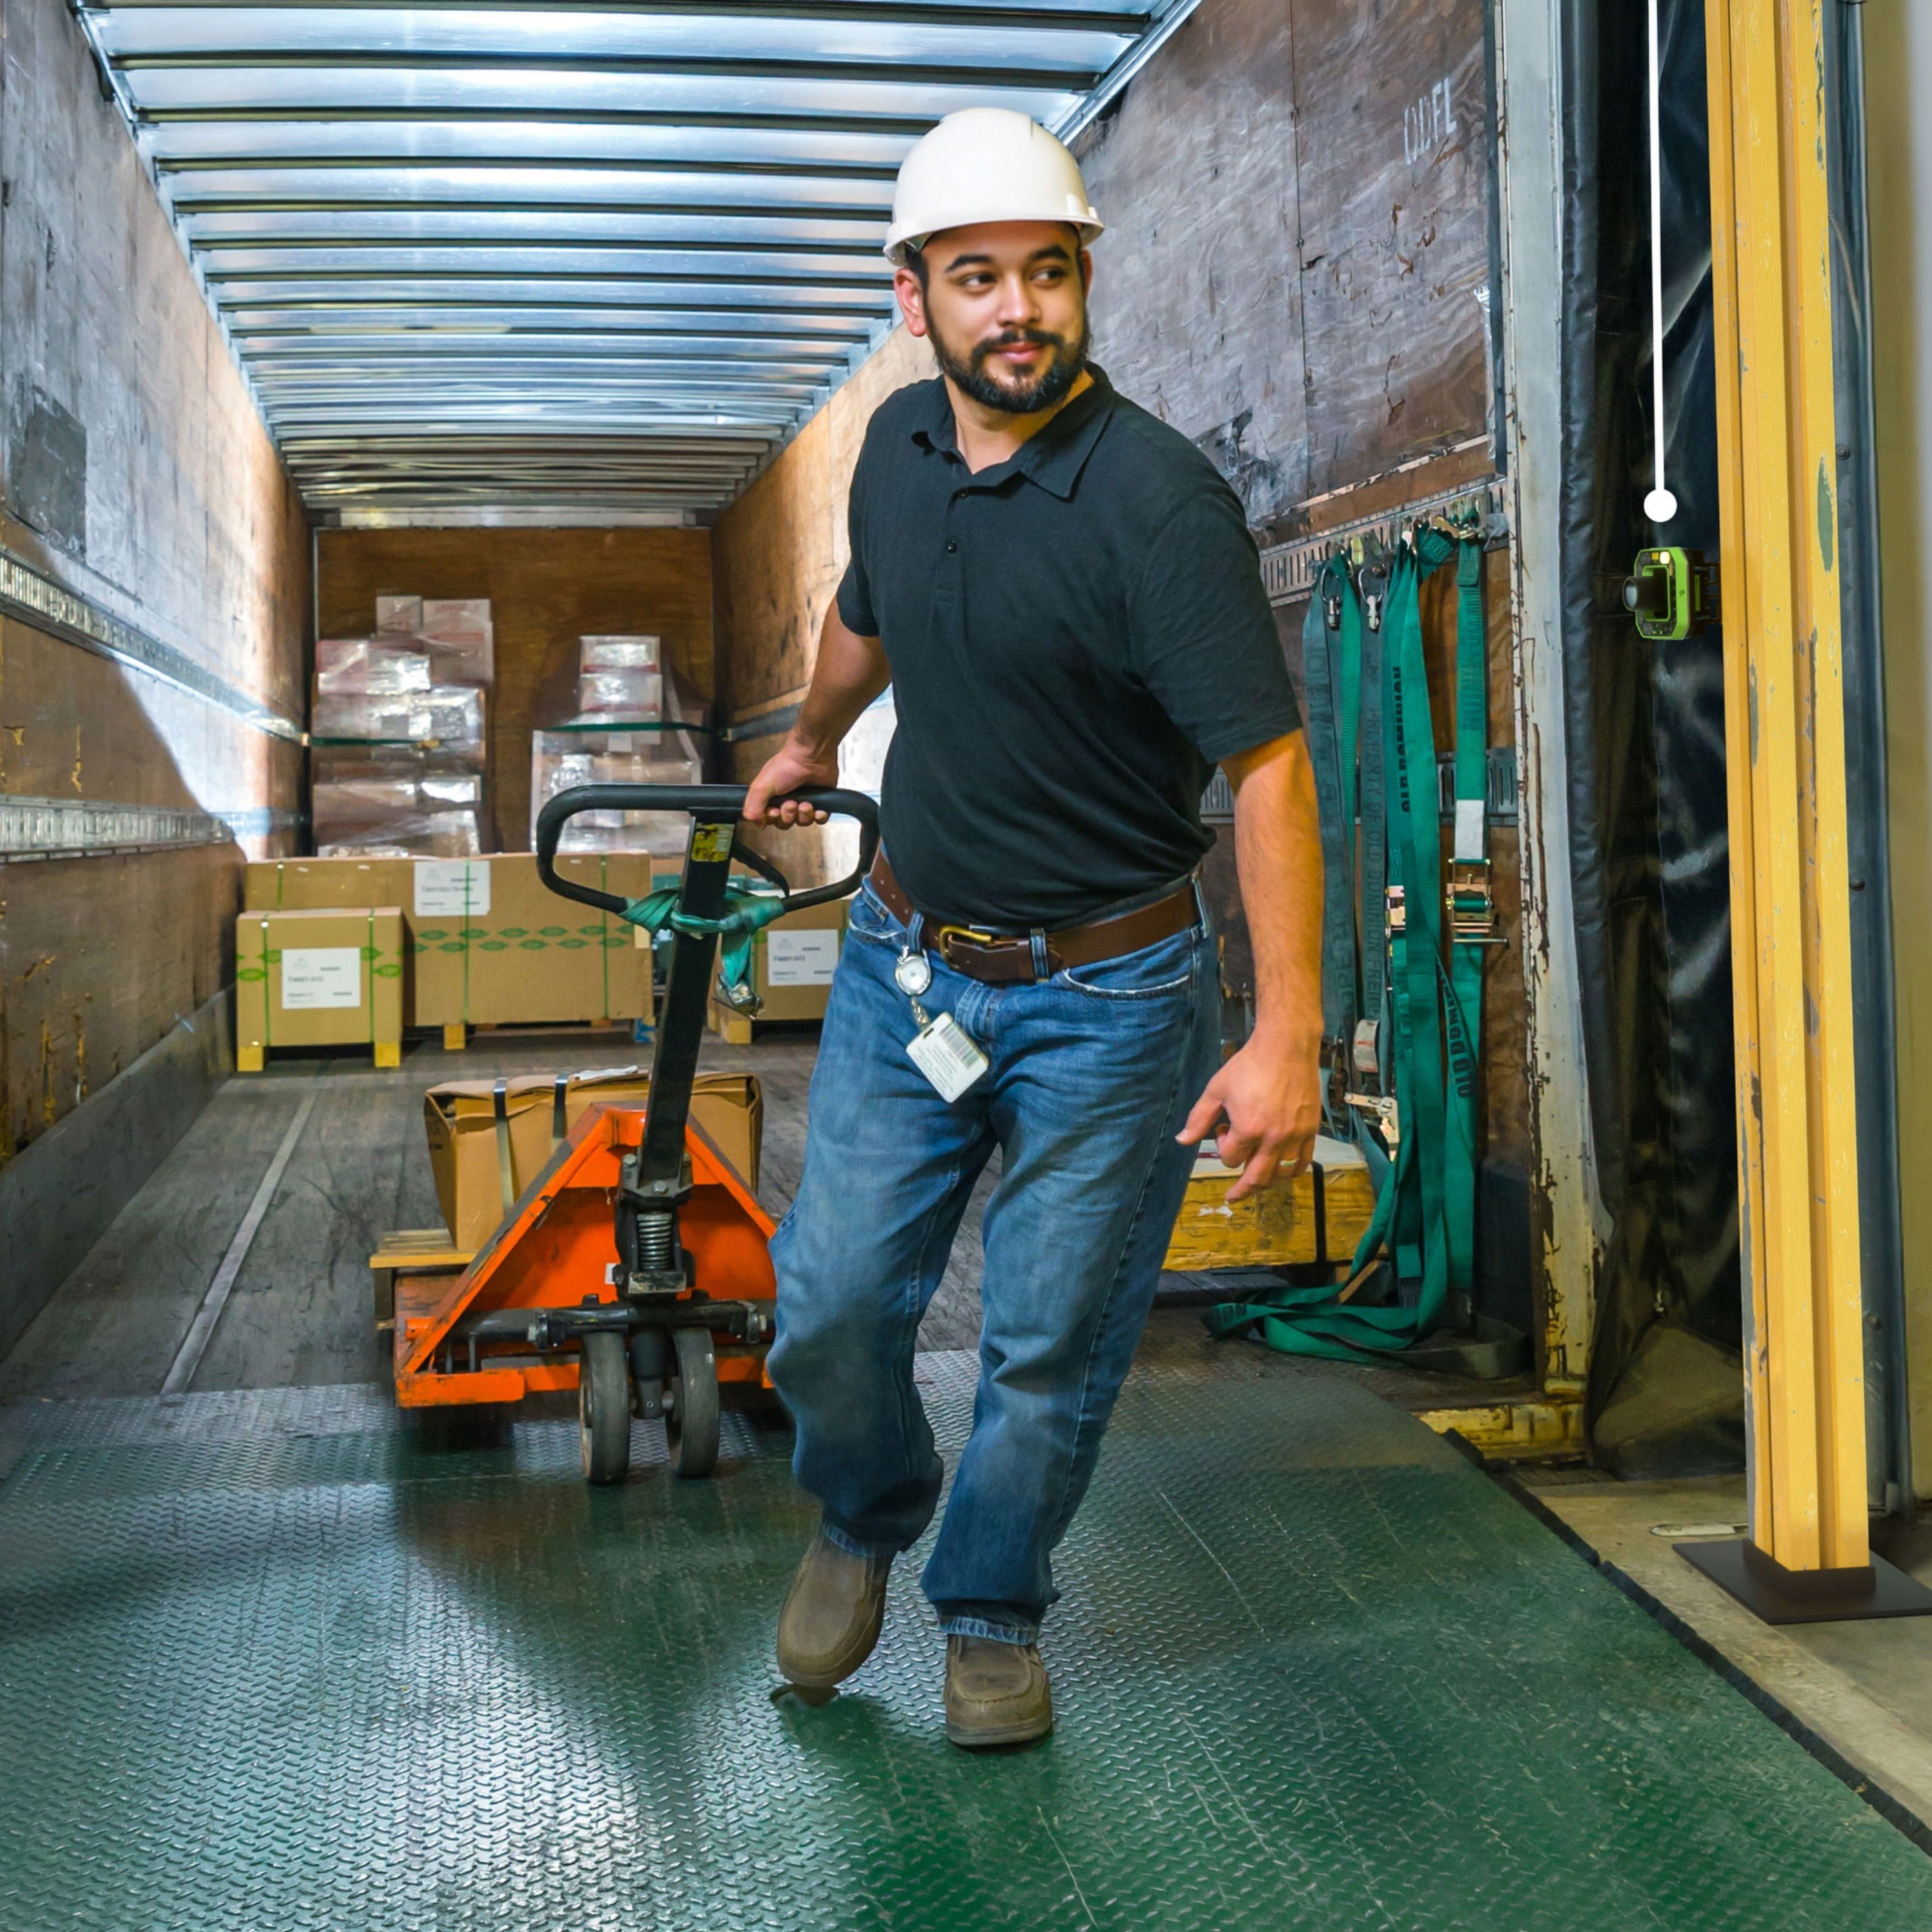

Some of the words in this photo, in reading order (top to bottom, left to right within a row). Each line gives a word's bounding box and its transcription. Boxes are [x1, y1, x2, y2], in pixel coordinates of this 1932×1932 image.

[1404, 76, 1457, 165] ODFL
[1365, 707, 1382, 795] PROPERTY
[1366, 802, 1382, 824] OF
[1367, 830, 1383, 862] OLD
[1367, 870, 1383, 952] DOMINION
[1367, 959, 1382, 1020] FREIGH
